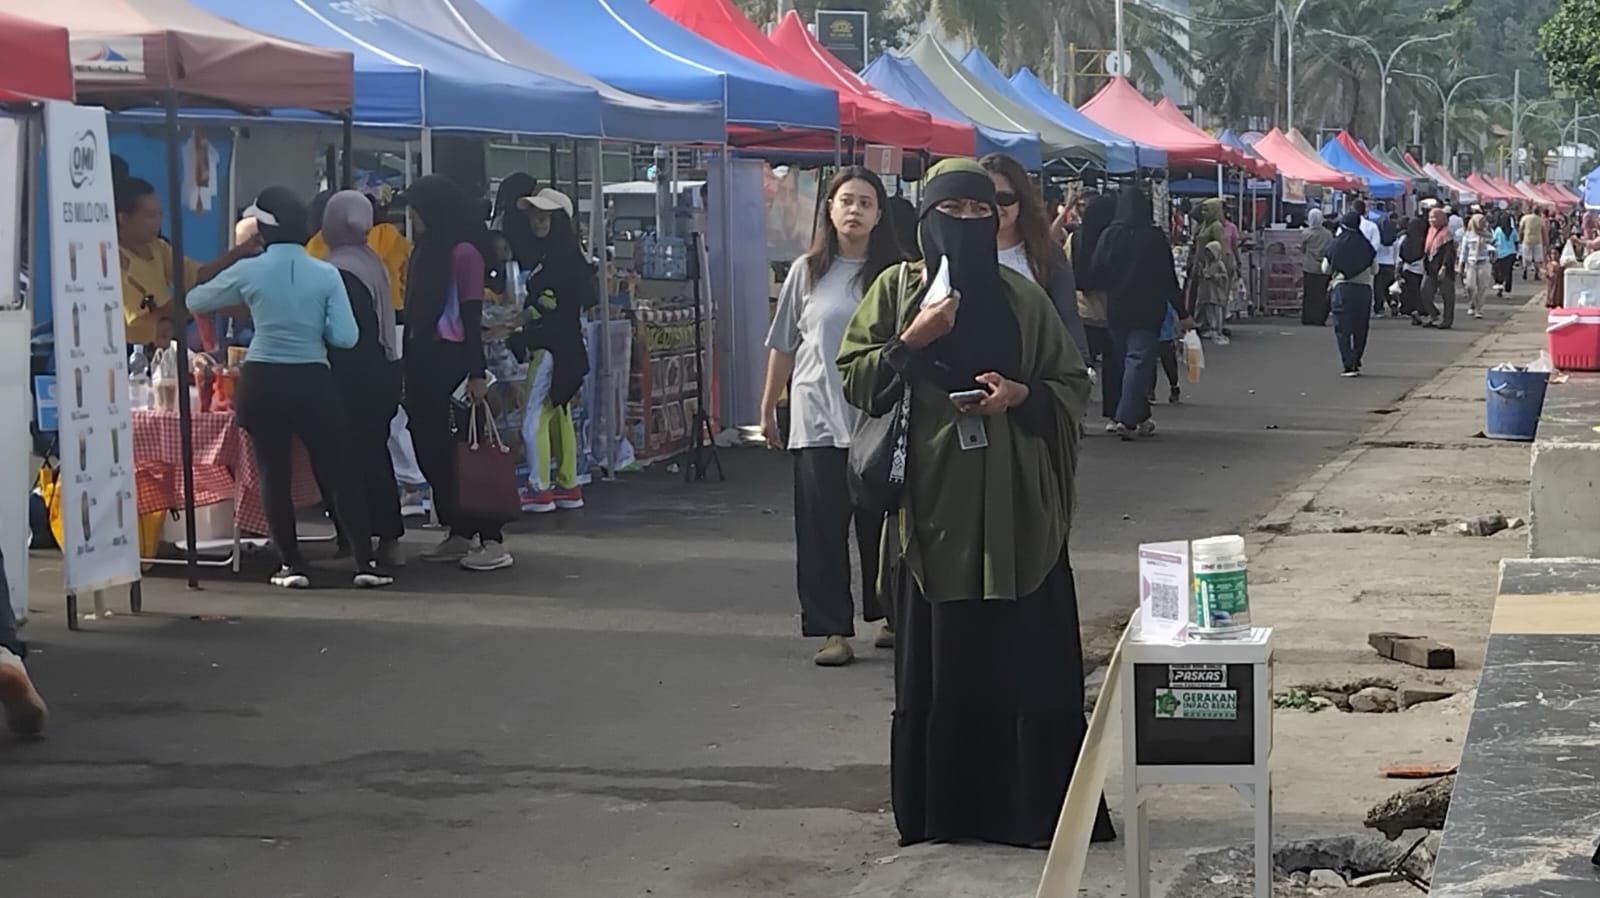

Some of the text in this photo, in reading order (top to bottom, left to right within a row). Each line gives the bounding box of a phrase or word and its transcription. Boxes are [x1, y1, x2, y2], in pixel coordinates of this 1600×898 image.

[74, 146, 94, 170] OMI
[63, 201, 73, 223] ES
[1174, 671, 1221, 681] PASKAS
[1183, 692, 1236, 702] GERAKAN
